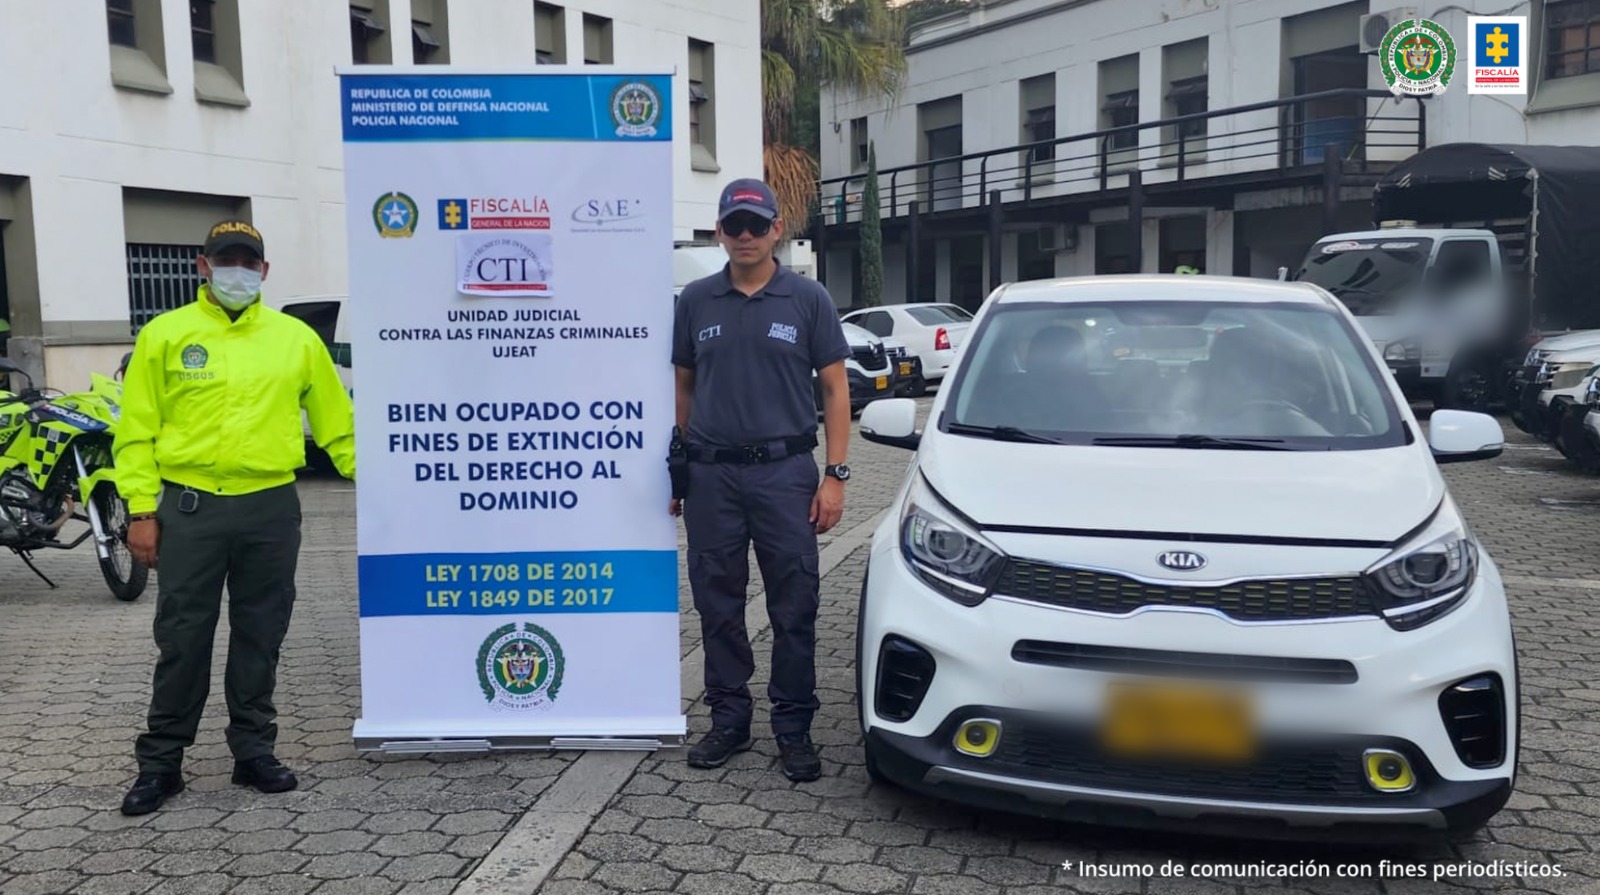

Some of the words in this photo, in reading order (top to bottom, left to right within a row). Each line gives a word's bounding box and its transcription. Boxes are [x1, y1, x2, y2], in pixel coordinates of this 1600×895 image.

[351, 88, 411, 99] REPUBLICA
[415, 88, 430, 99] DE
[431, 88, 492, 99] COLOMBIA
[352, 102, 417, 113] MINISTERIO
[420, 101, 435, 112] DE
[438, 101, 487, 112] DEFENSA
[490, 101, 549, 112] NACIONAL
[352, 115, 397, 126] POLICIA
[399, 115, 459, 126] NACIONAL
[470, 196, 549, 213] FISCALÍA
[588, 199, 629, 217] SAE
[472, 219, 503, 228] GENERAL
[504, 219, 513, 228] DE
[477, 258, 528, 282] CTI
[447, 310, 509, 322] UNIDAD
[512, 309, 581, 322] JUDICIAL
[379, 329, 442, 341] CONTRA
[446, 328, 473, 340] LAS
[477, 327, 555, 340] FINANZAS
[560, 326, 649, 339] CRIMINALES
[698, 325, 721, 342] CTI
[493, 346, 537, 358] UJEAT
[387, 404, 446, 423] BIEN
[455, 402, 580, 422] OCUPADO
[589, 401, 643, 420] CON
[389, 433, 459, 452] FINES
[468, 433, 498, 451] DE
[508, 425, 643, 450] EXTINCIÓN
[415, 463, 459, 481] DEL
[468, 461, 583, 481] DERECHO
[592, 461, 621, 479] AL
[460, 490, 578, 511] DOMINIO
[1164, 553, 1201, 567] KIA
[425, 565, 462, 582] LEY
[469, 564, 520, 582] 1708
[527, 563, 556, 581] DE
[562, 562, 613, 580] 2014
[426, 591, 462, 608] LEY
[469, 590, 520, 608] 1849
[528, 589, 555, 606] DE
[562, 588, 614, 606] 2017
